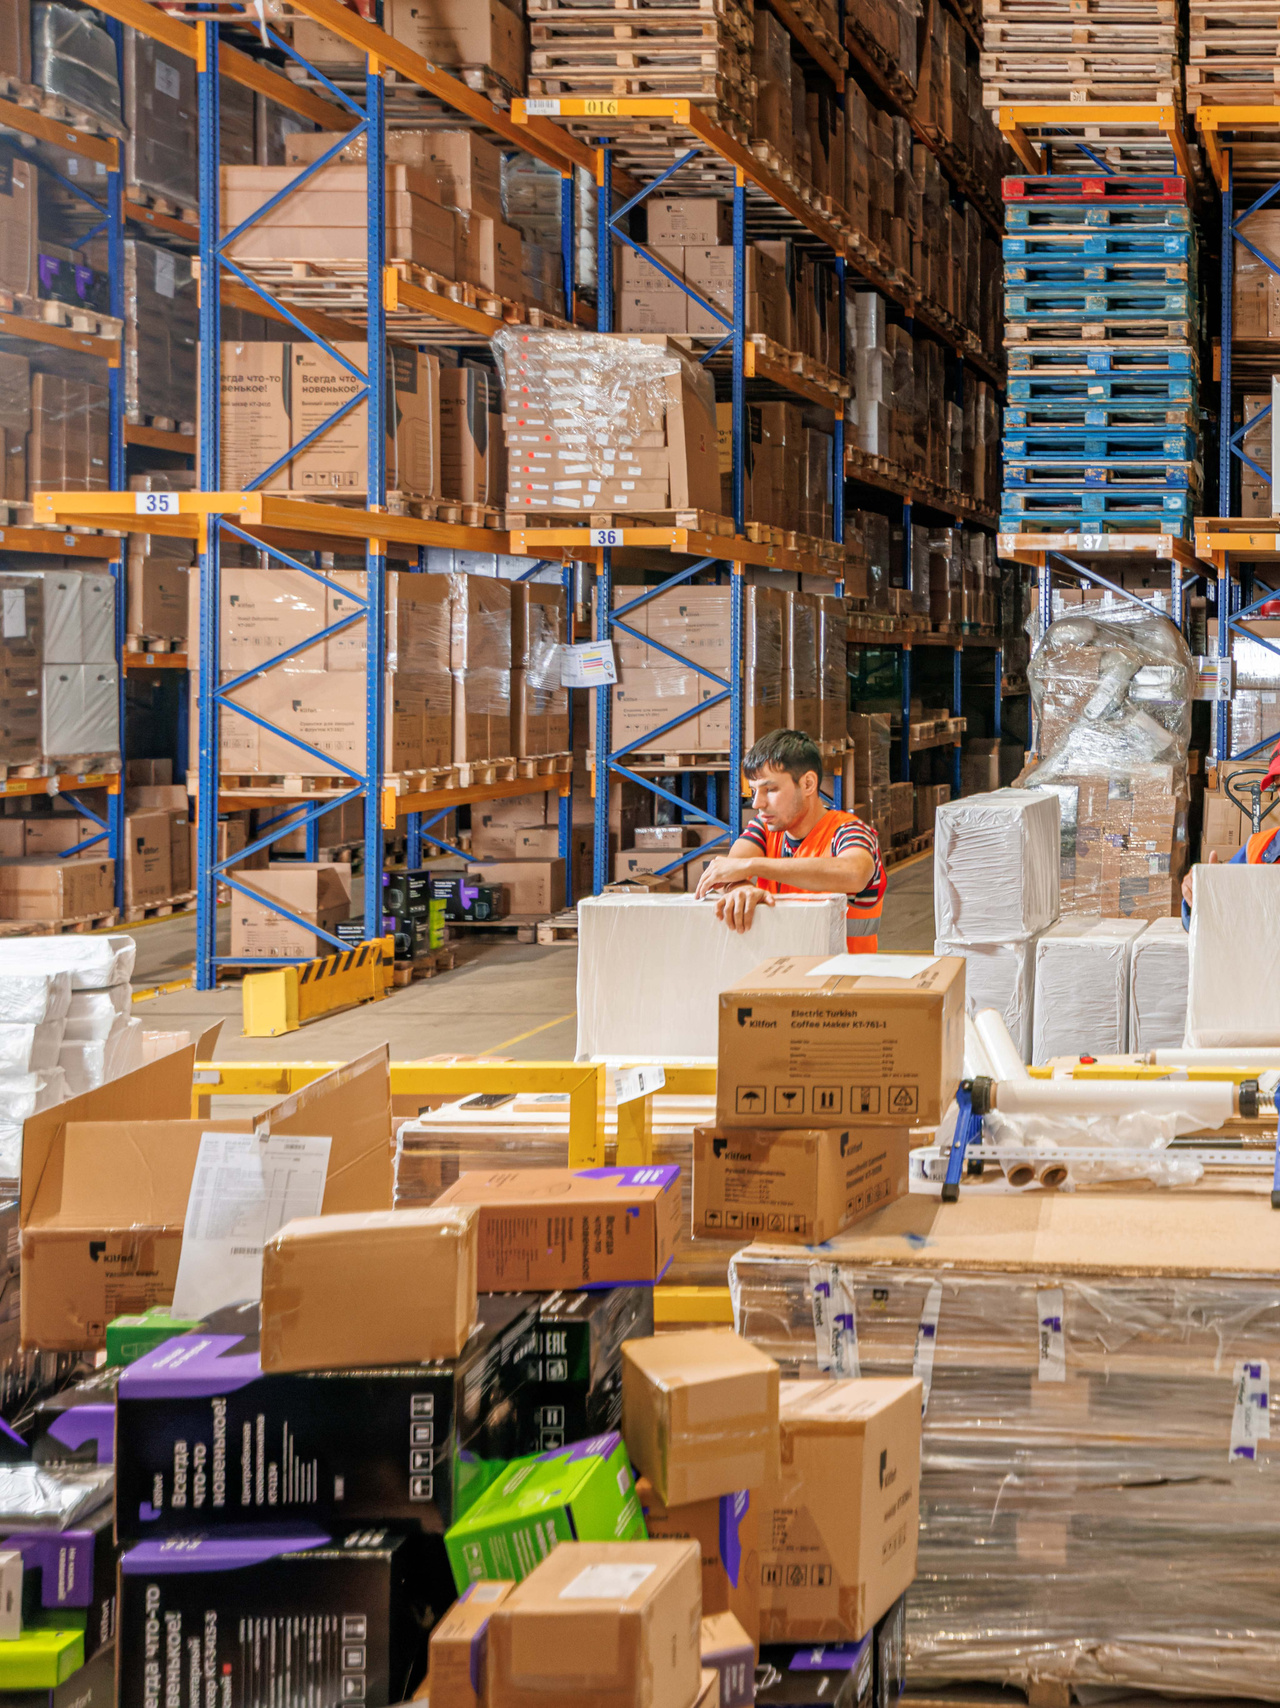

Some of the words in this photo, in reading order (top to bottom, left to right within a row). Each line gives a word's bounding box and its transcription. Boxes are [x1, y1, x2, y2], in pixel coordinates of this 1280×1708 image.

[587, 100, 616, 114] 016
[221, 375, 244, 384] егда
[246, 375, 281, 383] что-то
[302, 375, 336, 384] Всегда
[339, 375, 358, 384] что-
[221, 385, 268, 393] венькое!
[302, 385, 359, 394] новенькое!
[146, 494, 169, 512] 35
[597, 530, 617, 545] 36
[1083, 534, 1102, 550] 37
[791, 1010, 824, 1018] Electric
[826, 1010, 858, 1018] Turkish
[750, 1020, 777, 1029] Kitfort
[791, 1021, 820, 1029] Coffee
[822, 1020, 850, 1029] Maker
[725, 1152, 752, 1161] Kitfort
[606, 1215, 615, 1255] Всегда
[211, 1397, 227, 1508] новенькое!
[241, 1420, 252, 1507] Центробежная
[172, 1439, 190, 1509] Всегда
[193, 1441, 207, 1509] что-то
[146, 1583, 161, 1659] что-то
[164, 1610, 182, 1708] венькое!
[188, 1635, 202, 1708] нетарный
[144, 1659, 162, 1708] егда
[221, 1674, 232, 1708] сный
[204, 1678, 217, 1708] ксер
